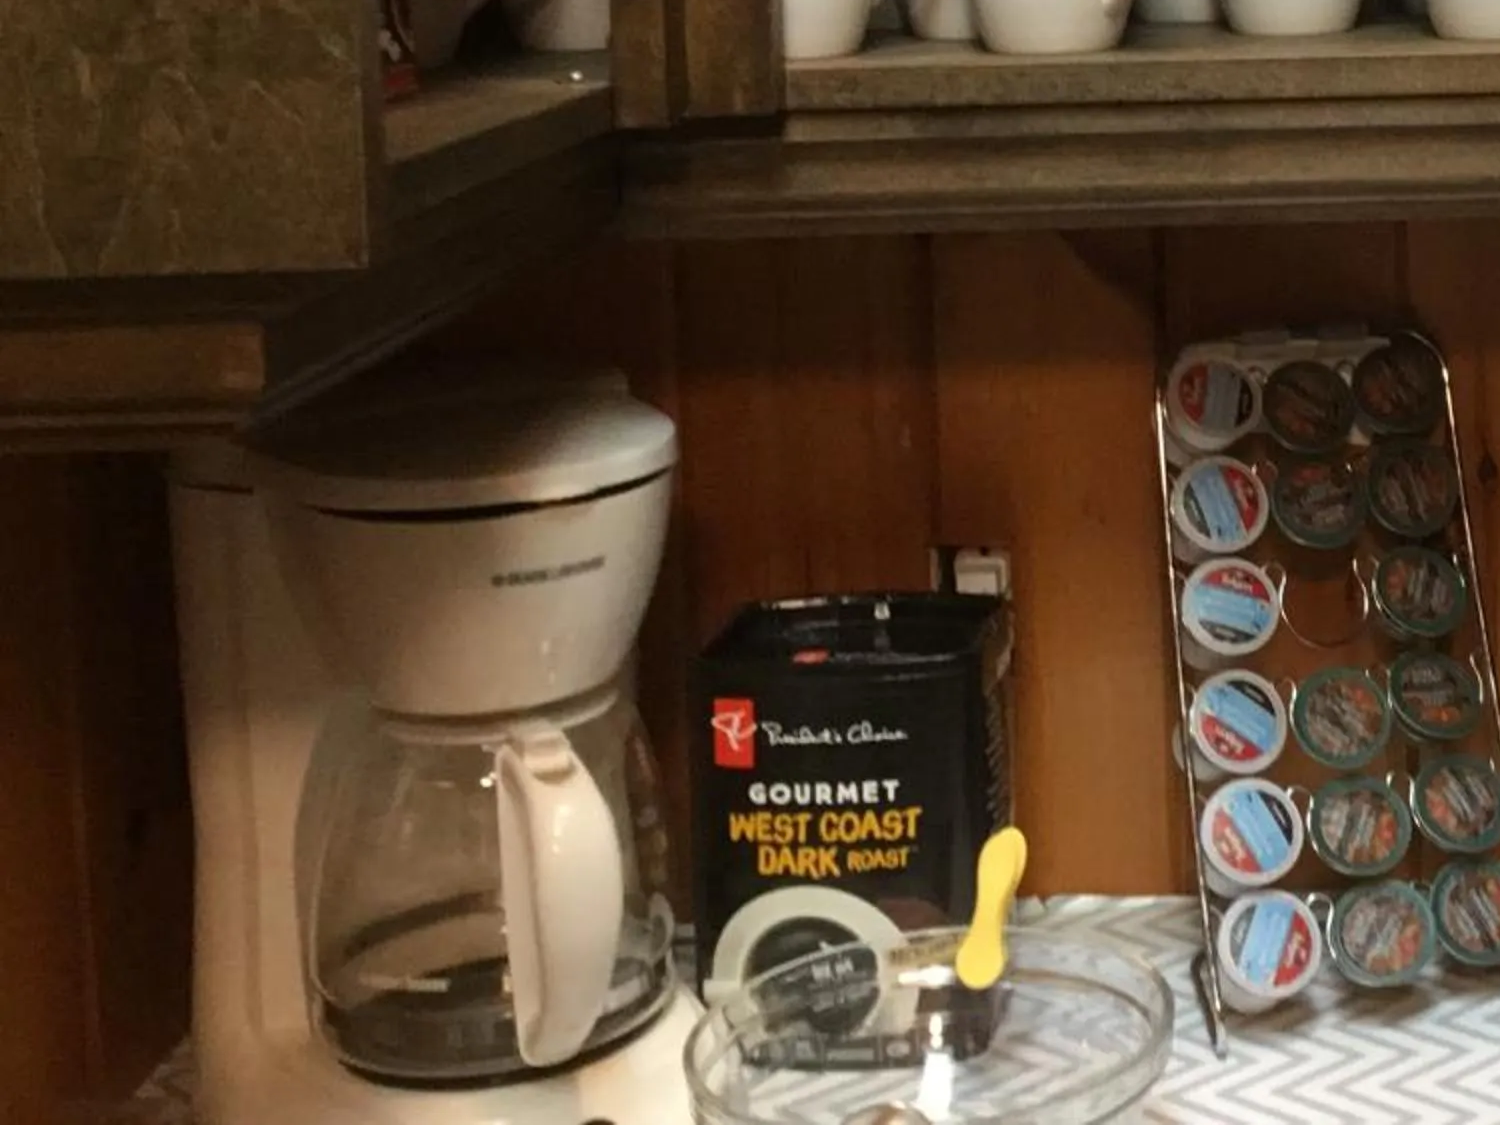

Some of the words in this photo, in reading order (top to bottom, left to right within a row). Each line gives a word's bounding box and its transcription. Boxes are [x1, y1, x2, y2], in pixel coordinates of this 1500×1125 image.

[748, 779, 900, 805] GOURMET
[729, 811, 812, 844] WEST
[819, 806, 923, 842] COAST
[758, 845, 841, 880] DARK
[847, 847, 911, 872] ROAST
